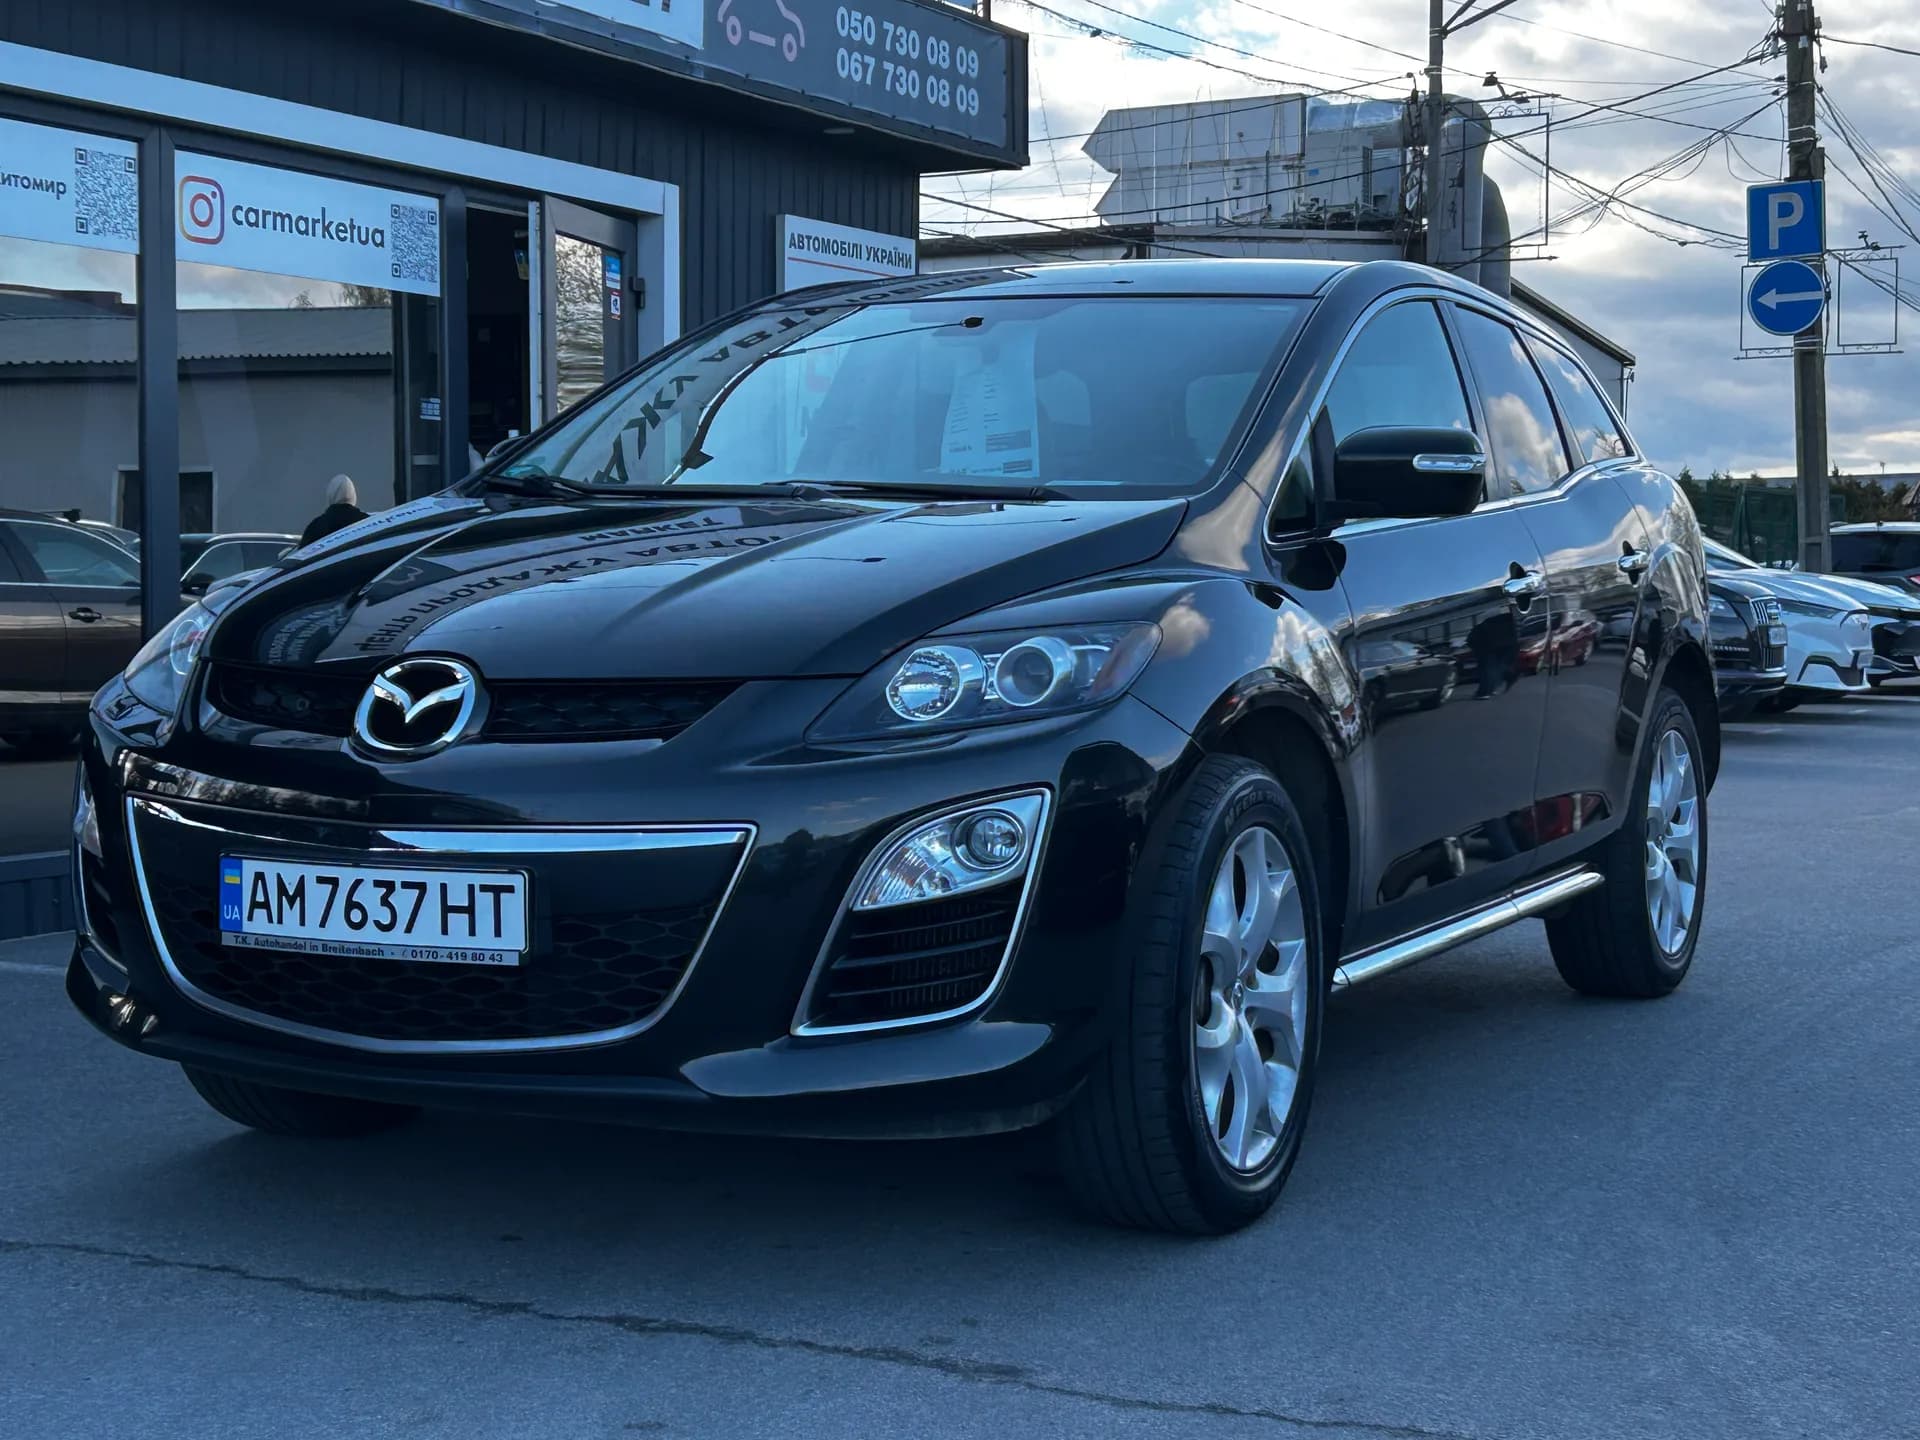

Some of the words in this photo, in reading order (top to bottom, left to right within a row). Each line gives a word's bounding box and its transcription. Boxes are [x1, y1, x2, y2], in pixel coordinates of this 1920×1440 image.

[836, 6, 876, 46] 050
[883, 21, 920, 59] 730
[926, 36, 950, 70] 08
[956, 46, 979, 78] 09
[836, 47, 876, 85] 067
[883, 61, 920, 98] 730
[926, 75, 950, 107] 08
[956, 84, 980, 116] 09
[0, 170, 67, 200] итомир
[231, 203, 385, 248] carmarketua
[1768, 192, 1804, 250] P
[788, 232, 863, 260] АВТОМОБІЛІ
[865, 244, 912, 270] УКРАЇНИ
[223, 904, 240, 920] UA
[253, 937, 307, 952] Autohandel
[309, 941, 319, 953] in
[321, 943, 384, 957] Breitenbach
